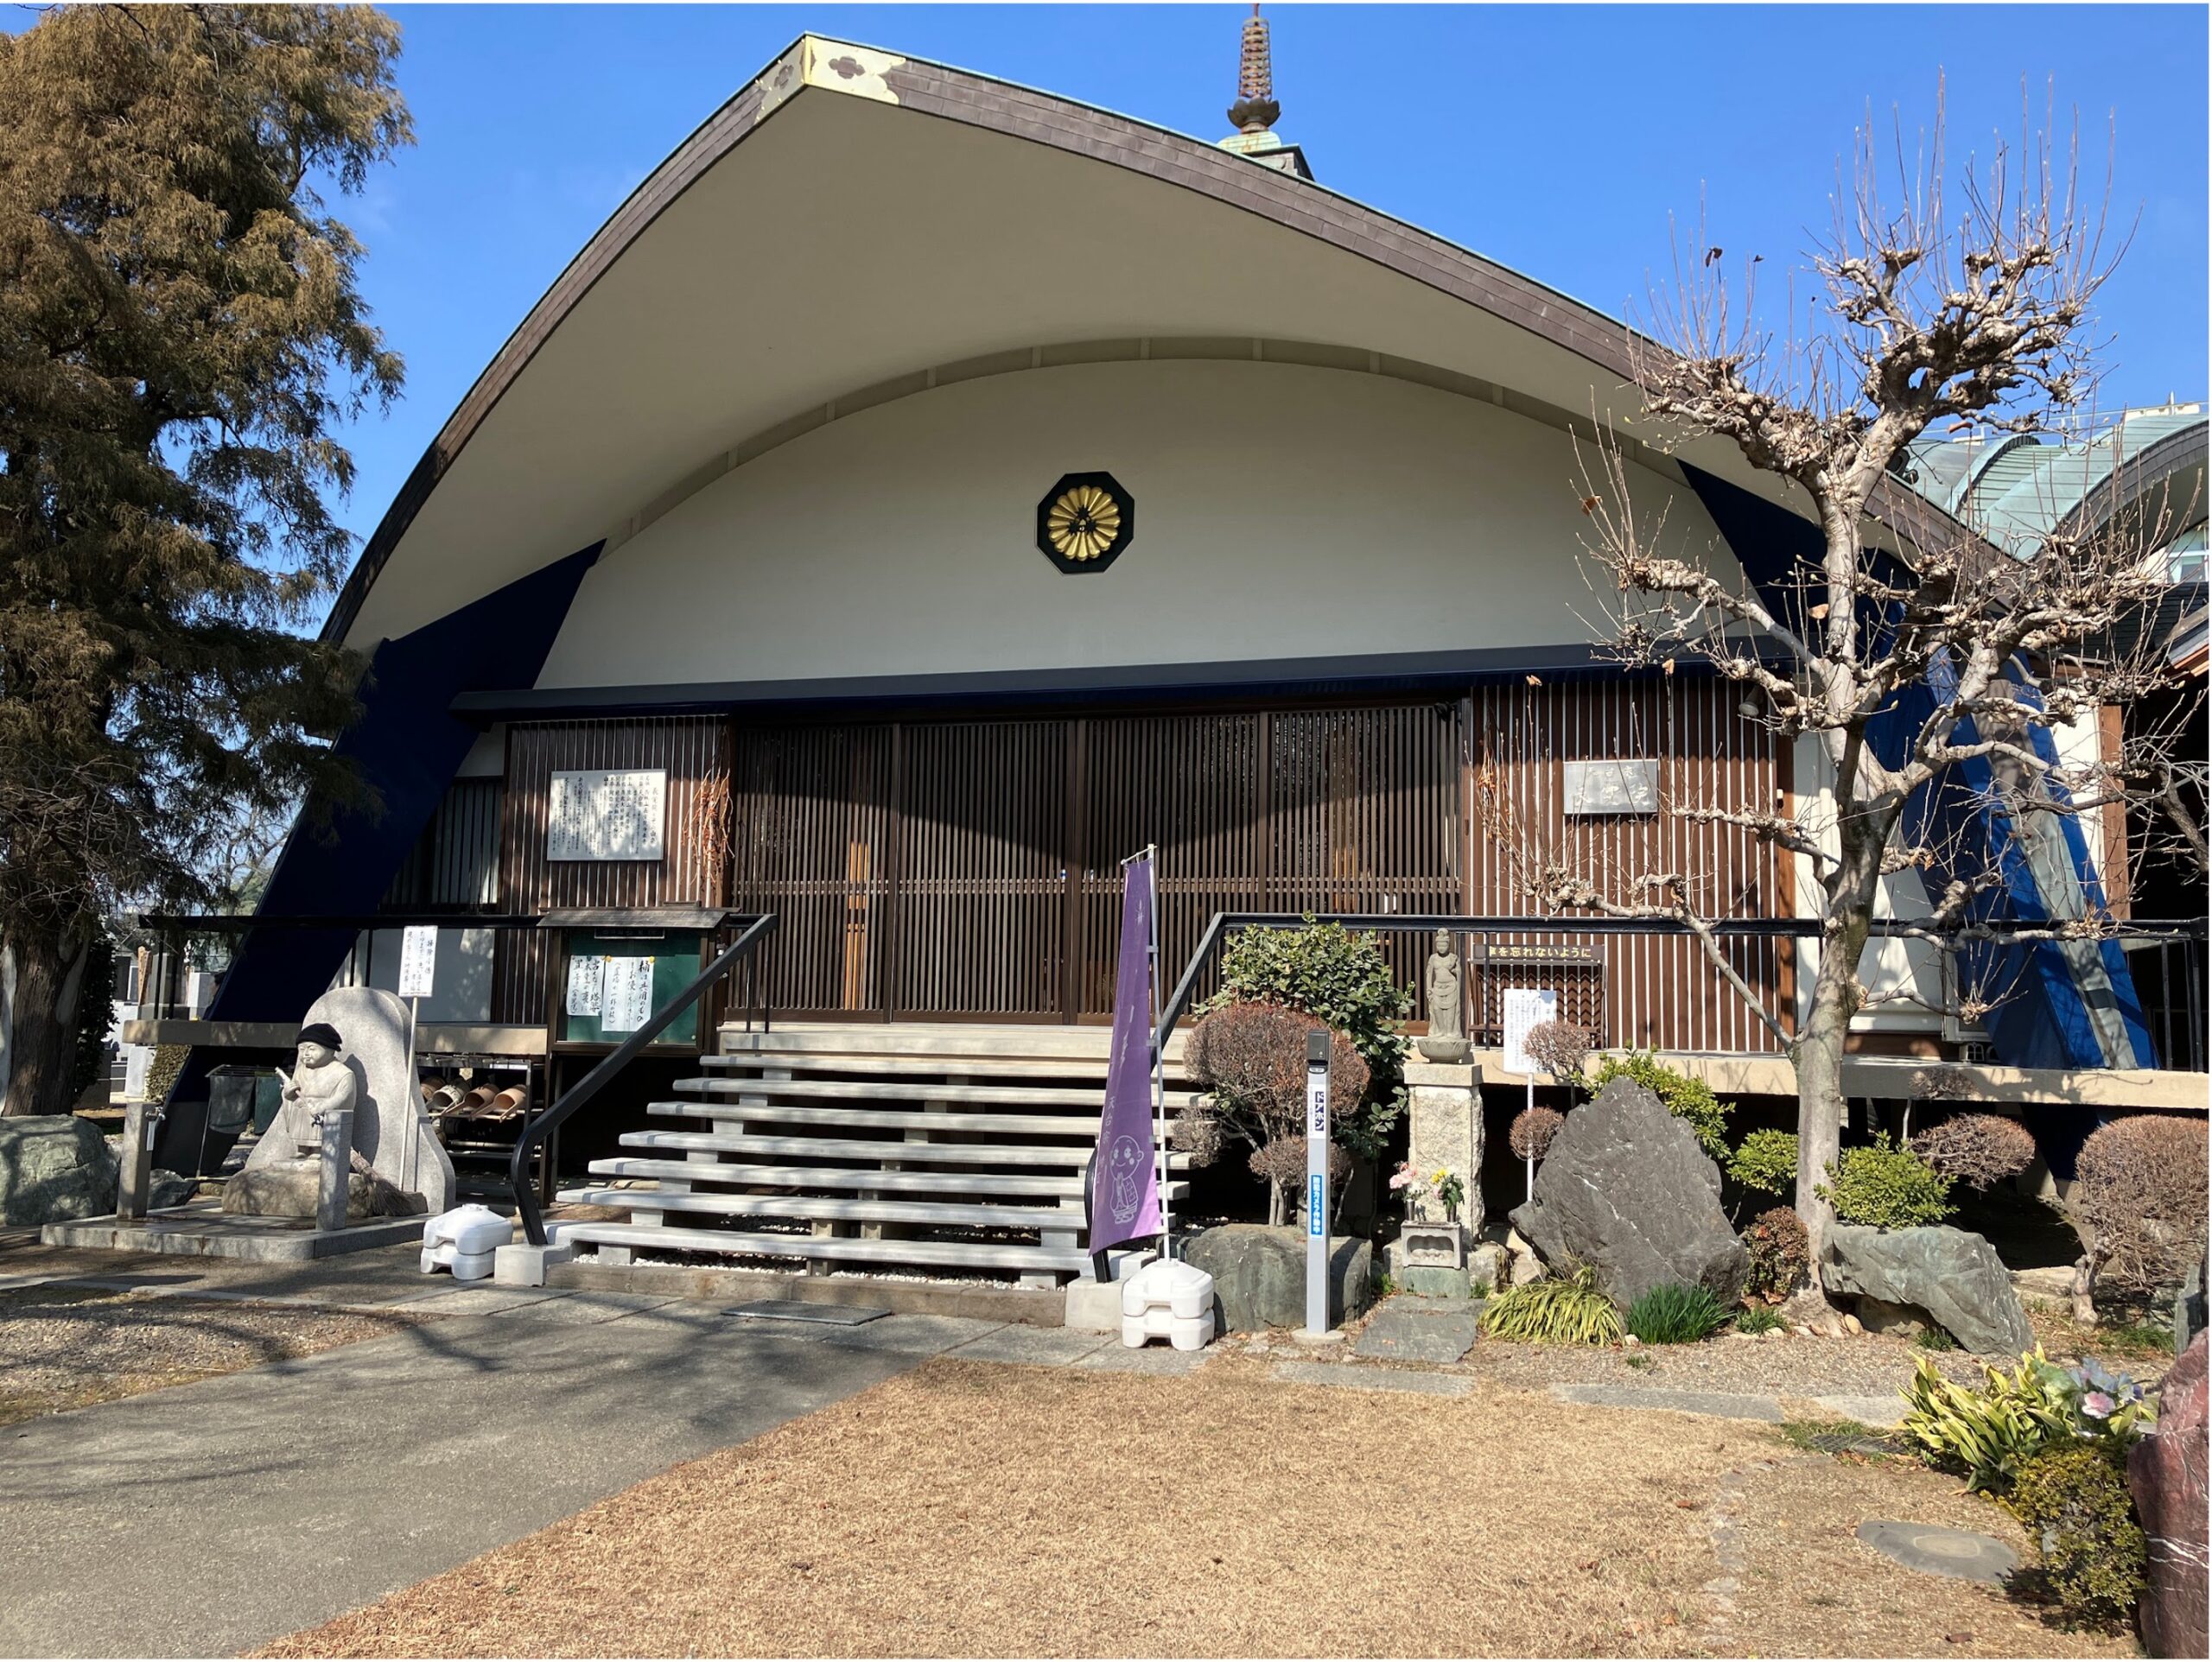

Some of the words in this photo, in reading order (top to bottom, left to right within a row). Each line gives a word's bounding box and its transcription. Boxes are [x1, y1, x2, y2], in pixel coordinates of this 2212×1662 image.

[1315, 1091, 1325, 1132] ドアホン
[1313, 1176, 1321, 1234] 防犯カメラ作動中
